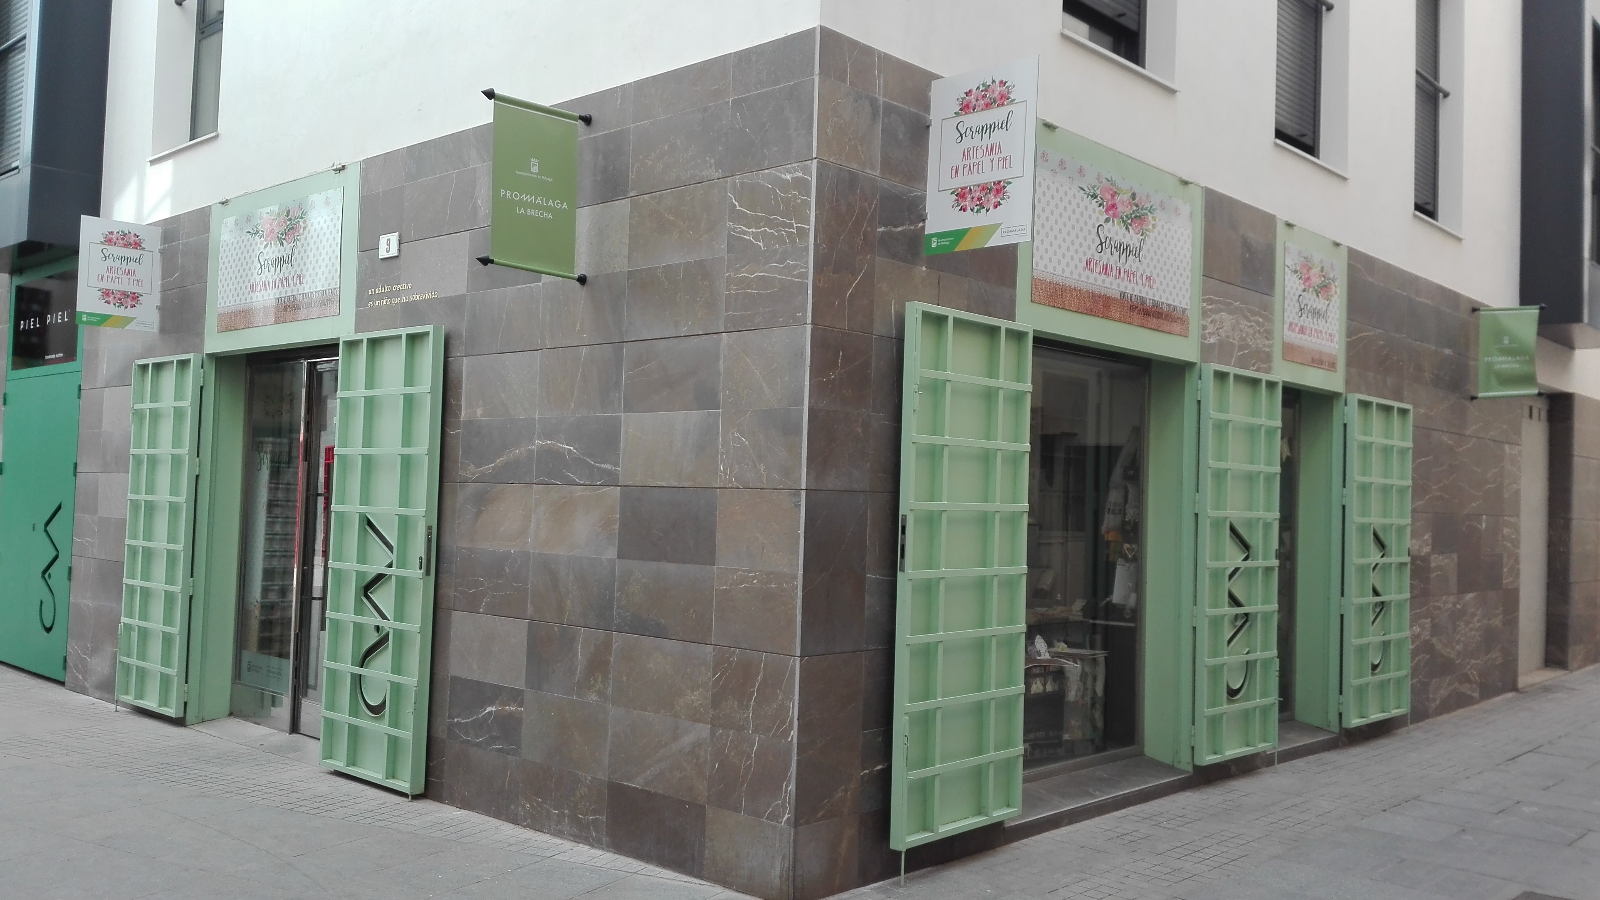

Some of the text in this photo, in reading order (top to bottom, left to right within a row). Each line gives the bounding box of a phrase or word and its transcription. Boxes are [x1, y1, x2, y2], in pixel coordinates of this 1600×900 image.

[955, 109, 1014, 144] Scrappiel
[950, 154, 1013, 179] EN PAPEL Y PIEL
[516, 206, 553, 219] LA BRECHA
[386, 237, 391, 253] 9
[1095, 223, 1145, 264] Scrappiel
[100, 247, 145, 266] Scrappiel
[375, 284, 392, 294] adulto
[392, 281, 413, 292] creativo
[19, 310, 68, 331] PIEL PIEL
